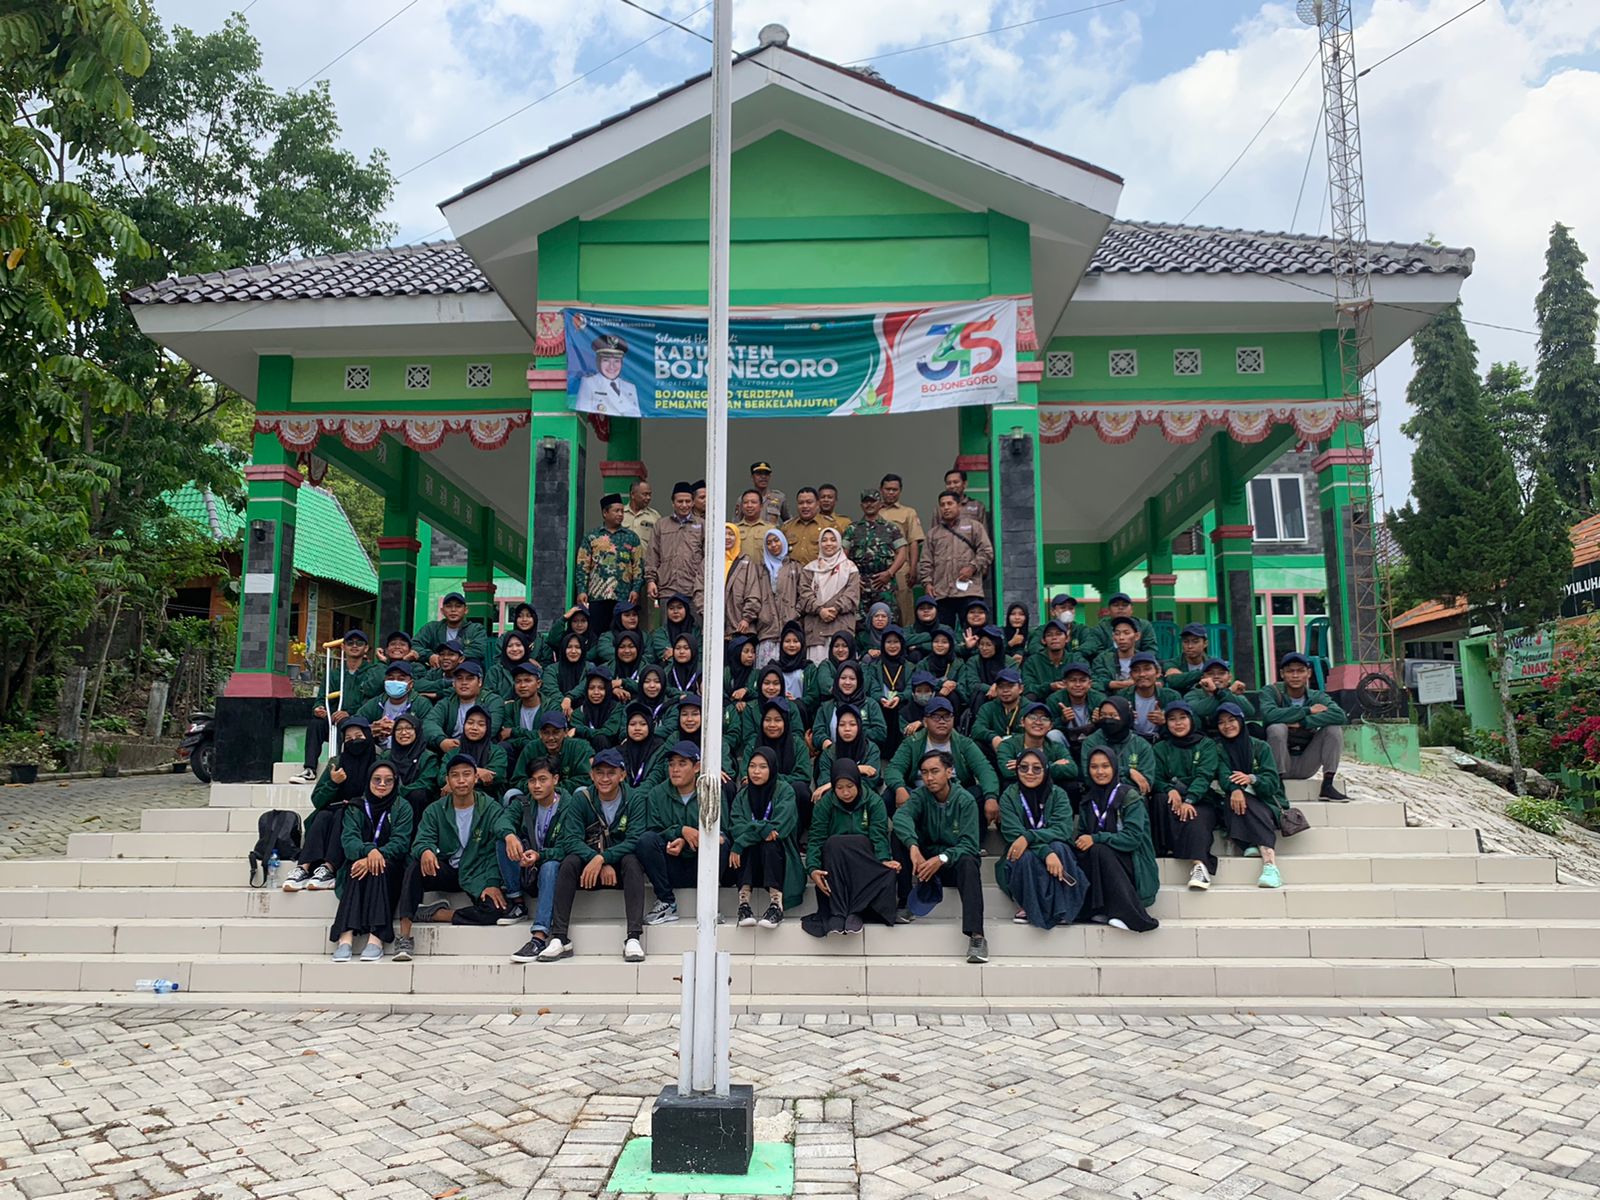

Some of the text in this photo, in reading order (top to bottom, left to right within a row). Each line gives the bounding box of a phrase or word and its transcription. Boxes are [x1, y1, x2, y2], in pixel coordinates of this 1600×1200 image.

[654, 345, 774, 360] KABUATEN
[655, 358, 839, 379] BOJNEGORO
[921, 375, 998, 393] BOJONEGORO
[655, 389, 794, 399] BOJONEGO TERDEPAN
[655, 398, 838, 409] PEMBANGAN BERKELANJUTAN
[1521, 661, 1548, 676] ANAK
